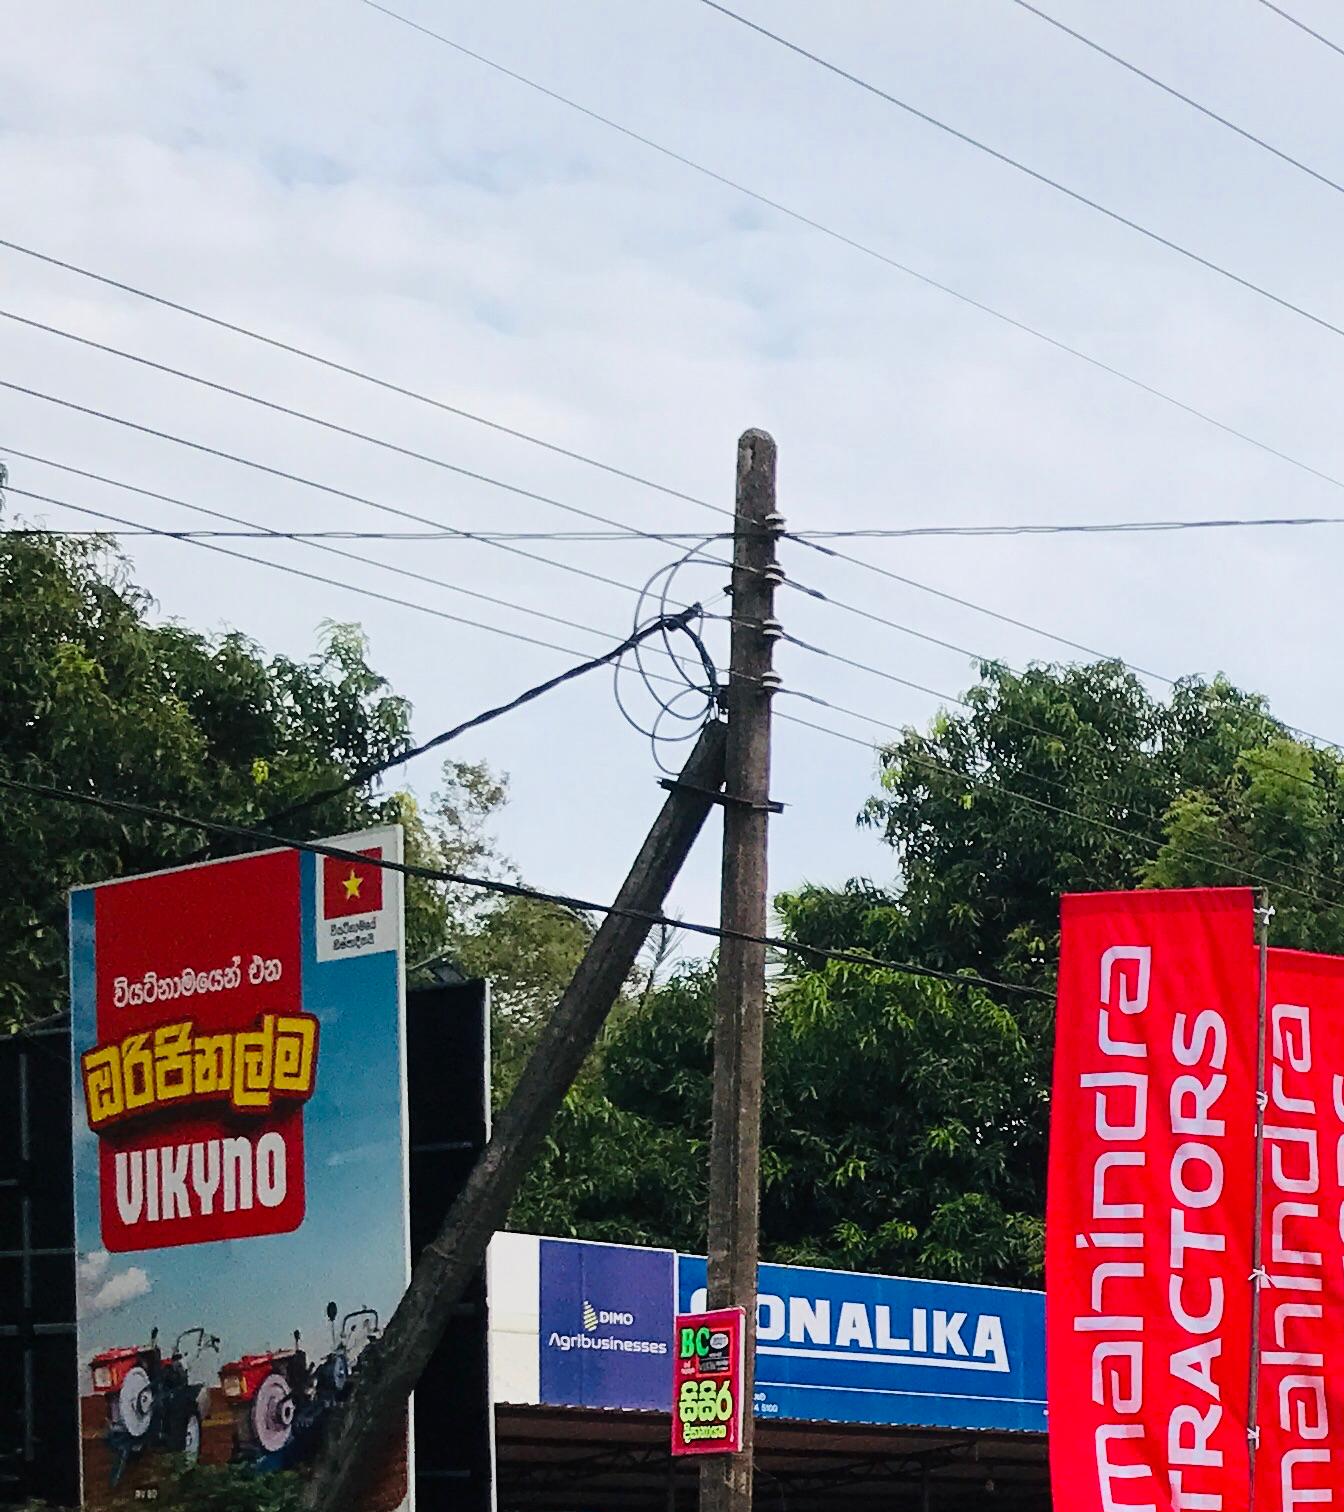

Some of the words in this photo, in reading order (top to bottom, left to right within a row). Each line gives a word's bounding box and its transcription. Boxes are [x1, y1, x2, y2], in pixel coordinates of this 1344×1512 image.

[248, 954, 283, 986] එන
[115, 1131, 287, 1226] VIKYNO
[599, 1311, 634, 1326] DIMO
[548, 1332, 668, 1355] Agribusinesses
[680, 1327, 710, 1358] BC
